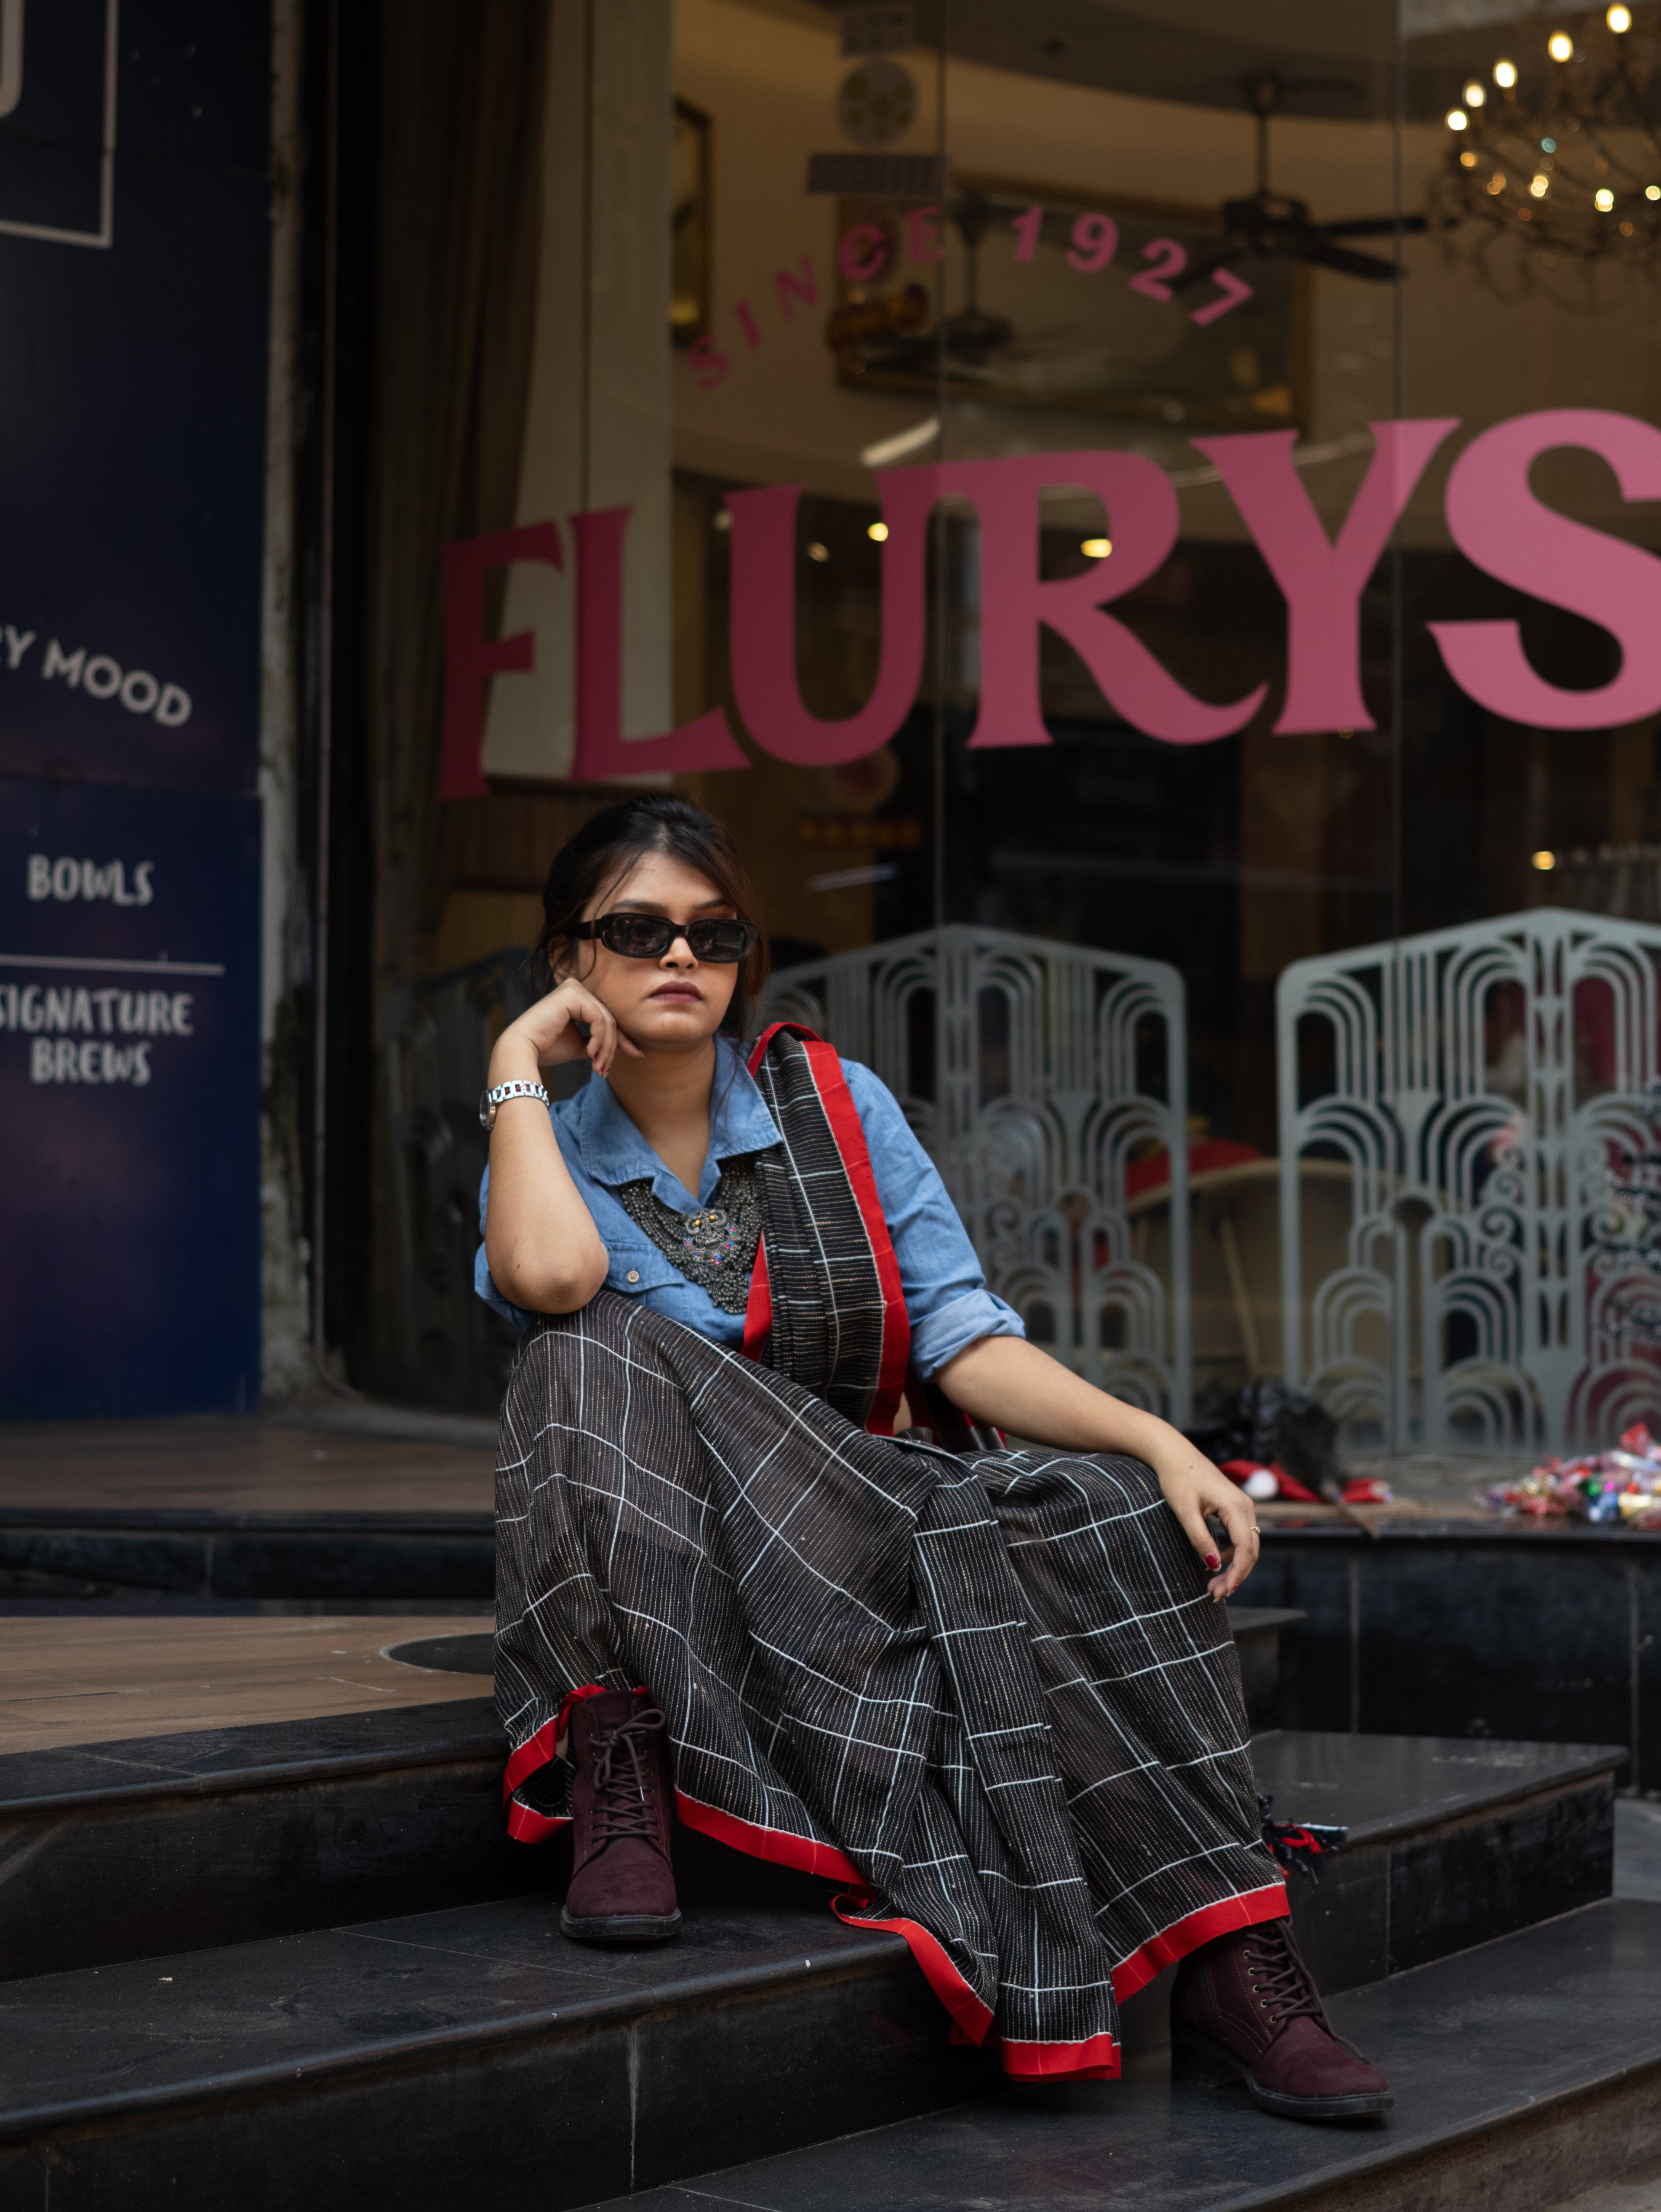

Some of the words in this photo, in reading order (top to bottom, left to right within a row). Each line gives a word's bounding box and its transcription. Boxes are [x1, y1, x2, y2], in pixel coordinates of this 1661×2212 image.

[688, 207, 946, 388] SINCE
[1011, 206, 1253, 326] 1927
[439, 408, 1661, 800] FLURYS
[0, 623, 36, 670] Y
[42, 638, 193, 727] MOOD
[28, 854, 154, 905] BOWLS
[31, 1037, 152, 1086] BREWS
